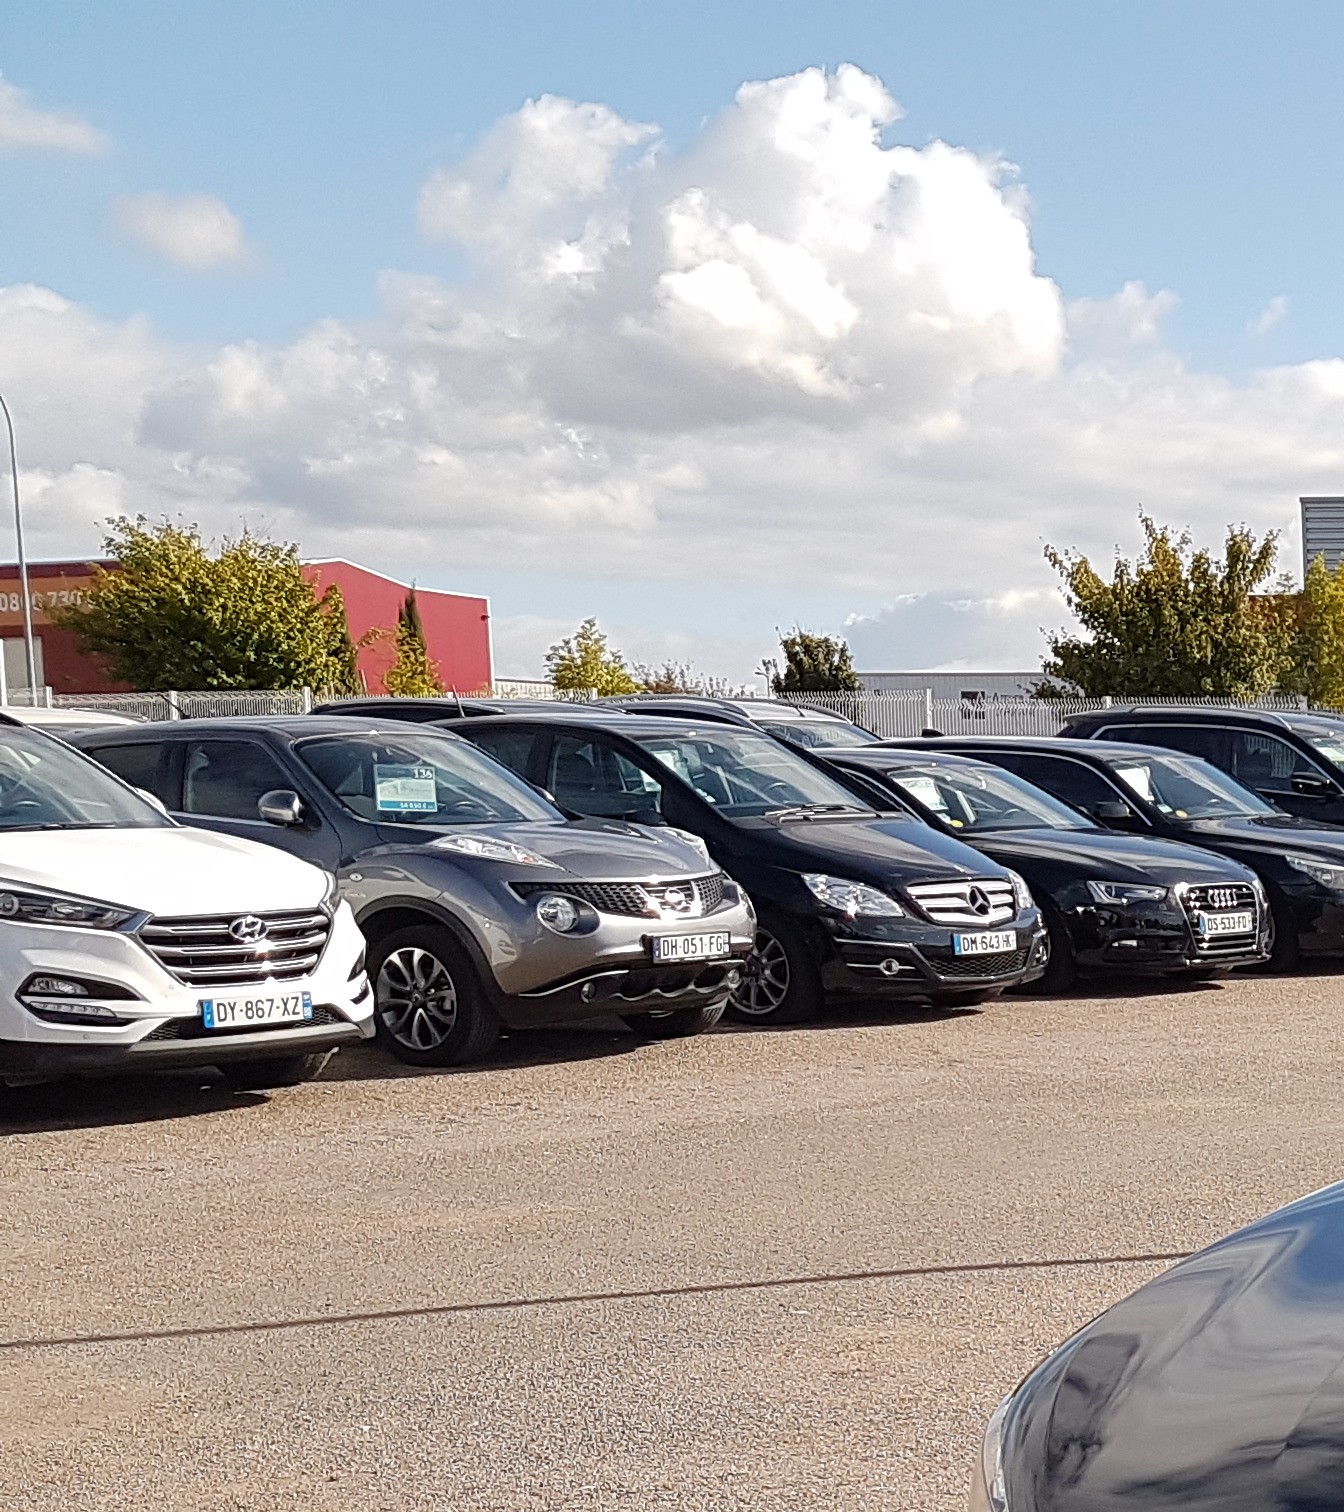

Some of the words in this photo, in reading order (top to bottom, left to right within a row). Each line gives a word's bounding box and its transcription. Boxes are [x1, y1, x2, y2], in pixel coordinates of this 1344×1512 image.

[0, 592, 43, 612] 080
[662, 935, 722, 957] DH-051-FG
[216, 996, 301, 1023] DY-867-XZ
